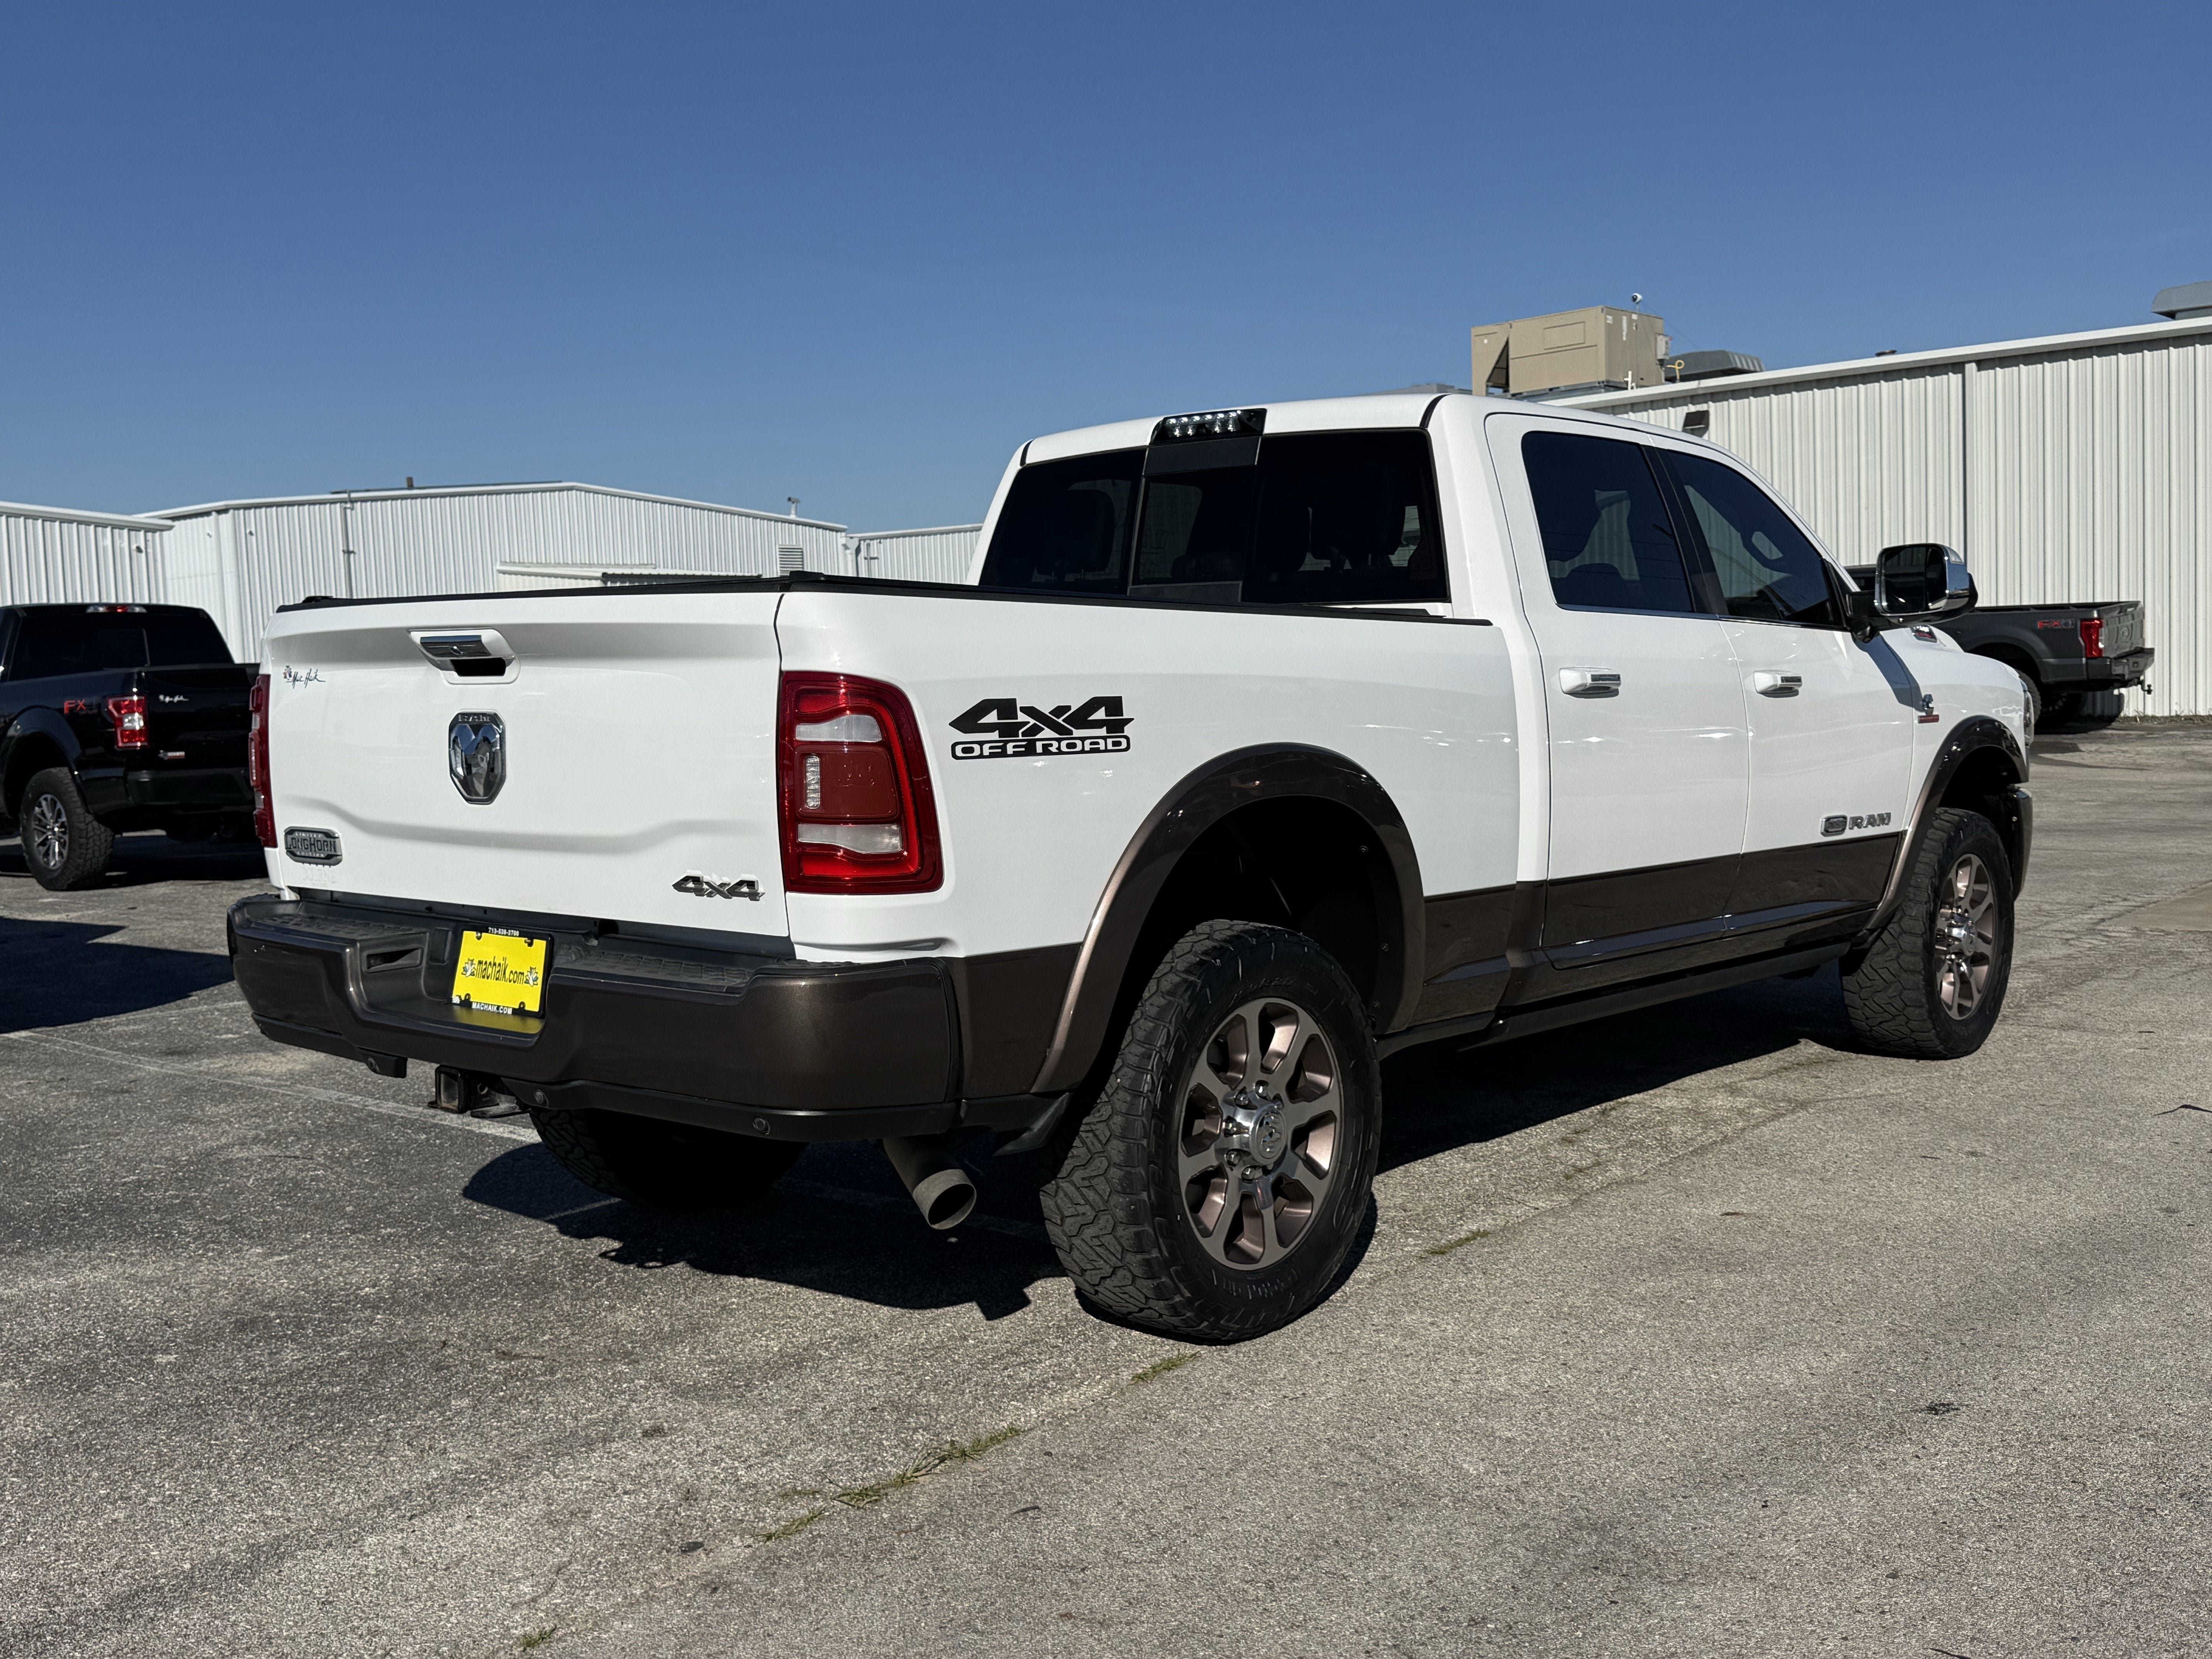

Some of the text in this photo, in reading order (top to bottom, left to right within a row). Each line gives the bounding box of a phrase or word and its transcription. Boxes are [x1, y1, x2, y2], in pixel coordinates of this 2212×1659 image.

[955, 738, 1127, 757] OFF ROAD
[1848, 812, 1891, 830] RAM
[475, 955, 524, 985] machaik.com
[472, 1002, 512, 1014] MACHAIK.COM
